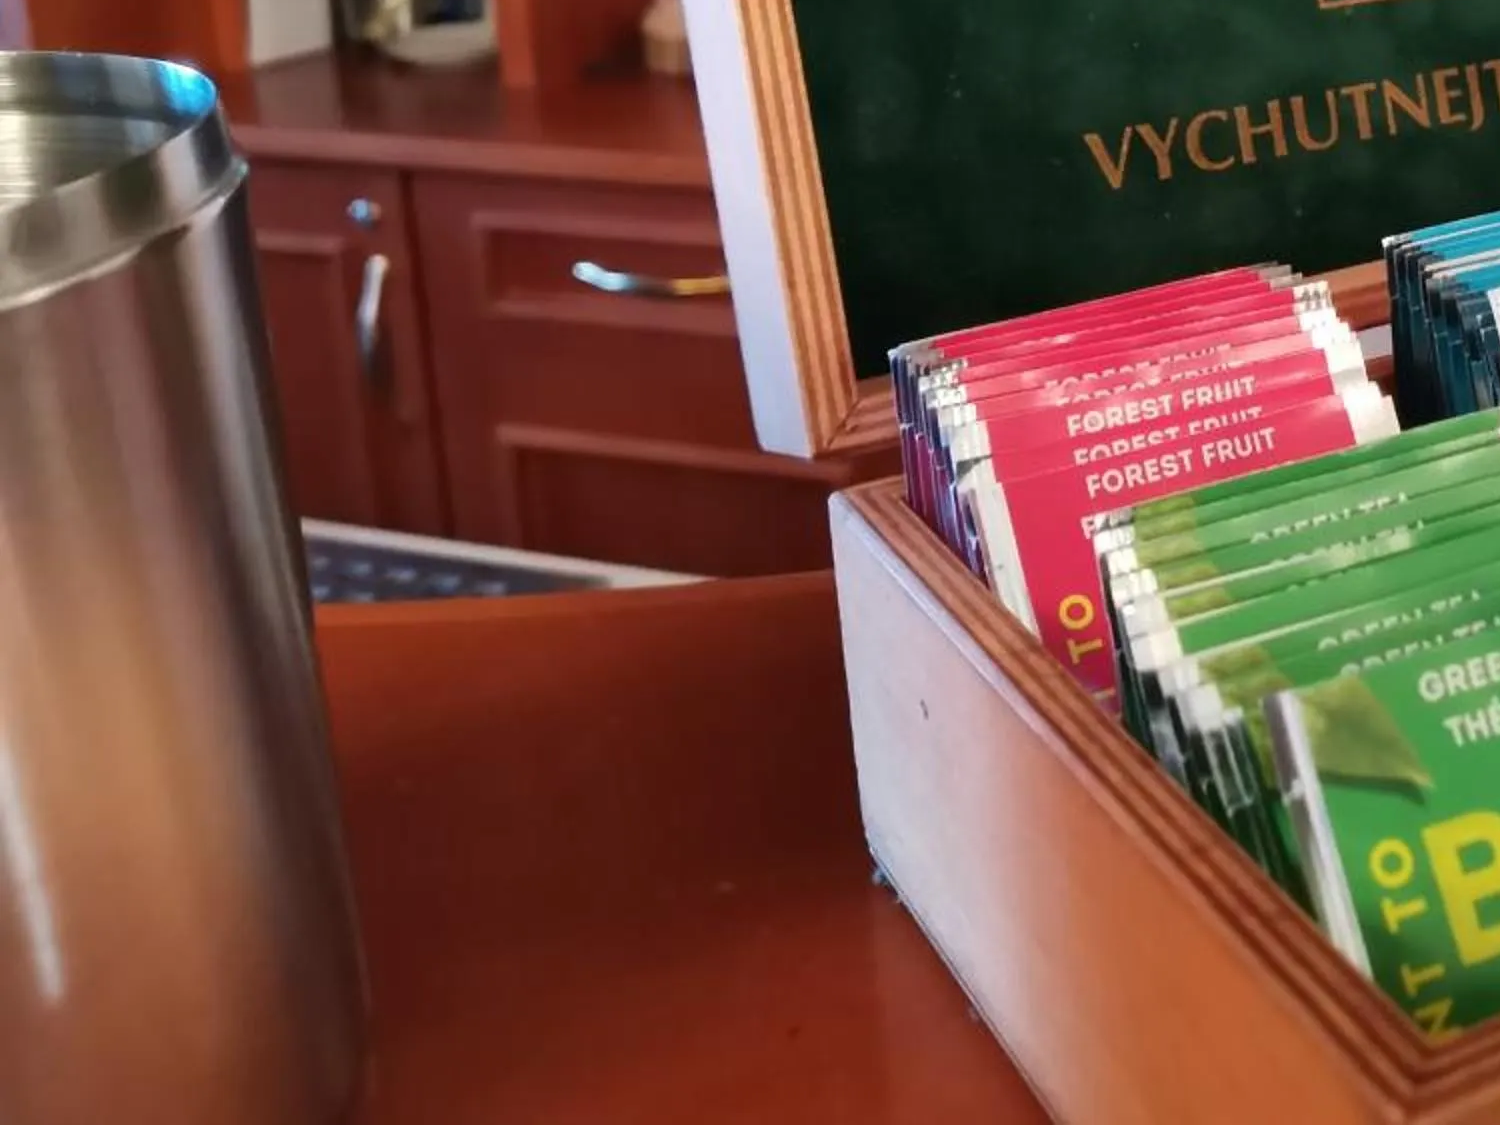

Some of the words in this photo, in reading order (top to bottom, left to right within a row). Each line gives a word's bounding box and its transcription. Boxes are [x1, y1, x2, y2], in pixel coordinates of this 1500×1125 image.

[1066, 393, 1173, 438] FOREST
[1180, 375, 1257, 411] FRUIT
[1085, 448, 1194, 499] FOREST
[1201, 427, 1277, 468] FRUIT
[1058, 593, 1104, 666] TO
[1368, 837, 1428, 935] TO
